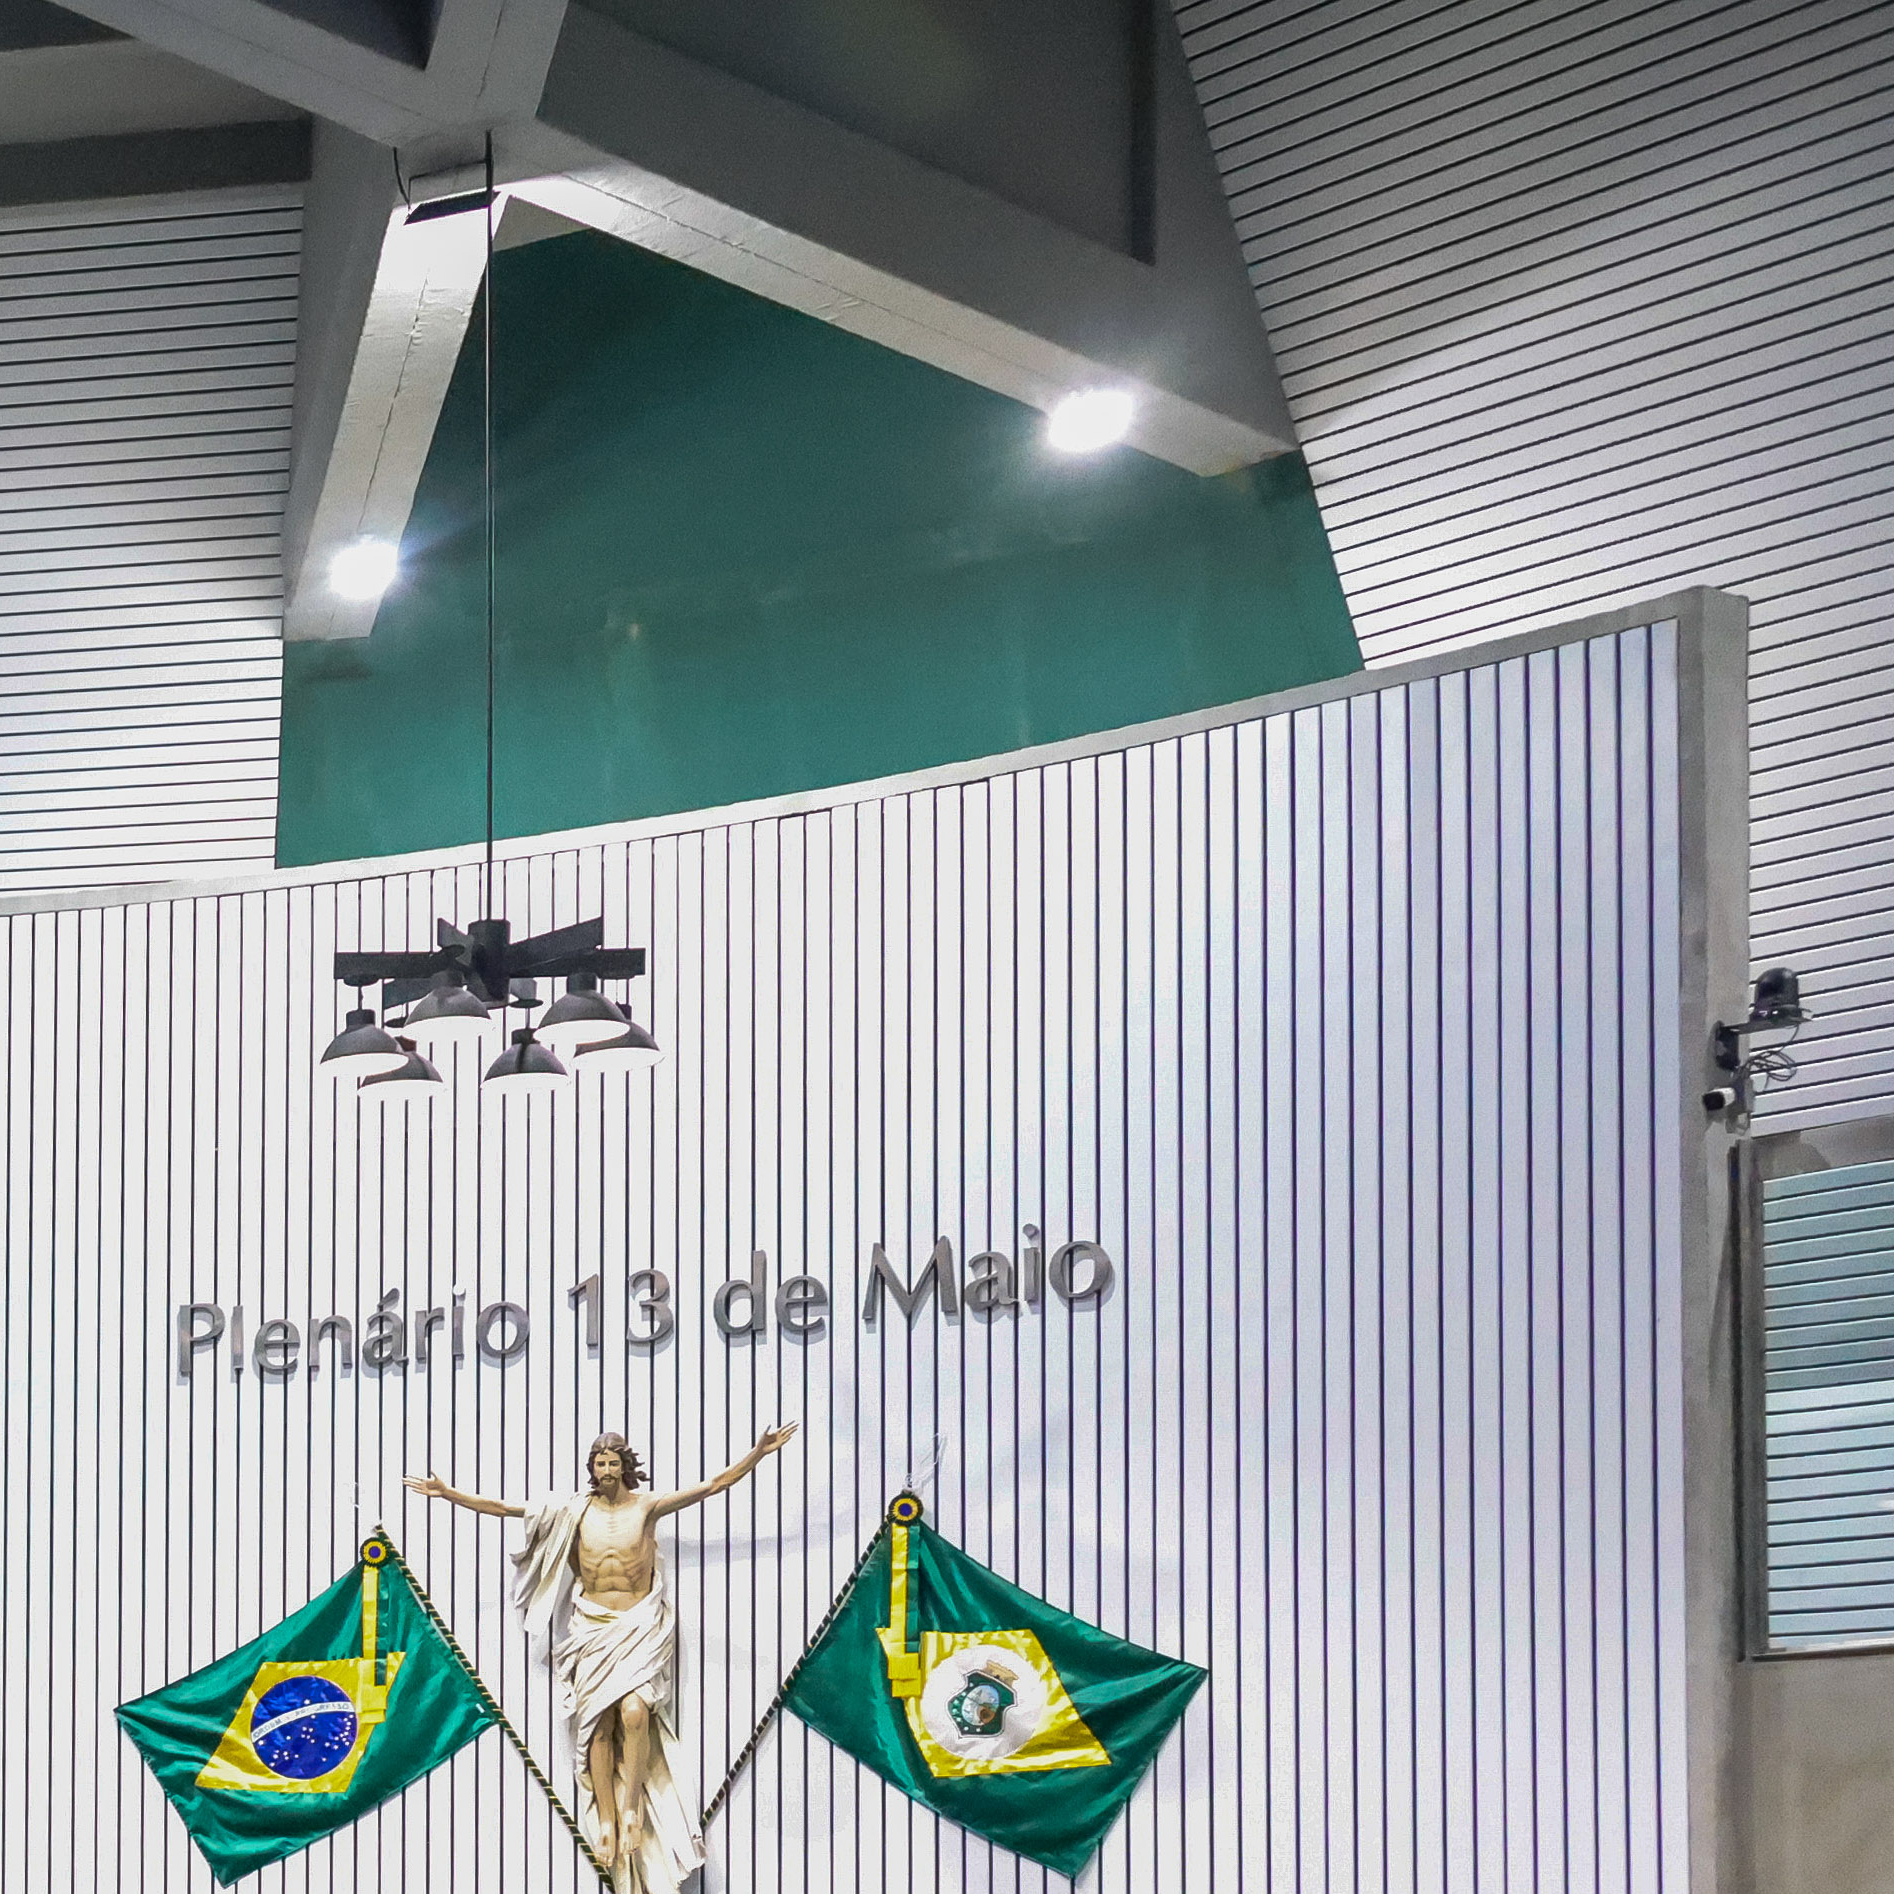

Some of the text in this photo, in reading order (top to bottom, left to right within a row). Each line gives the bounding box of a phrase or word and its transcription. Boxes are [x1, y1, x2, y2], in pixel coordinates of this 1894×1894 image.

[178, 1224, 1115, 1378] Plenário 13 de Maio
